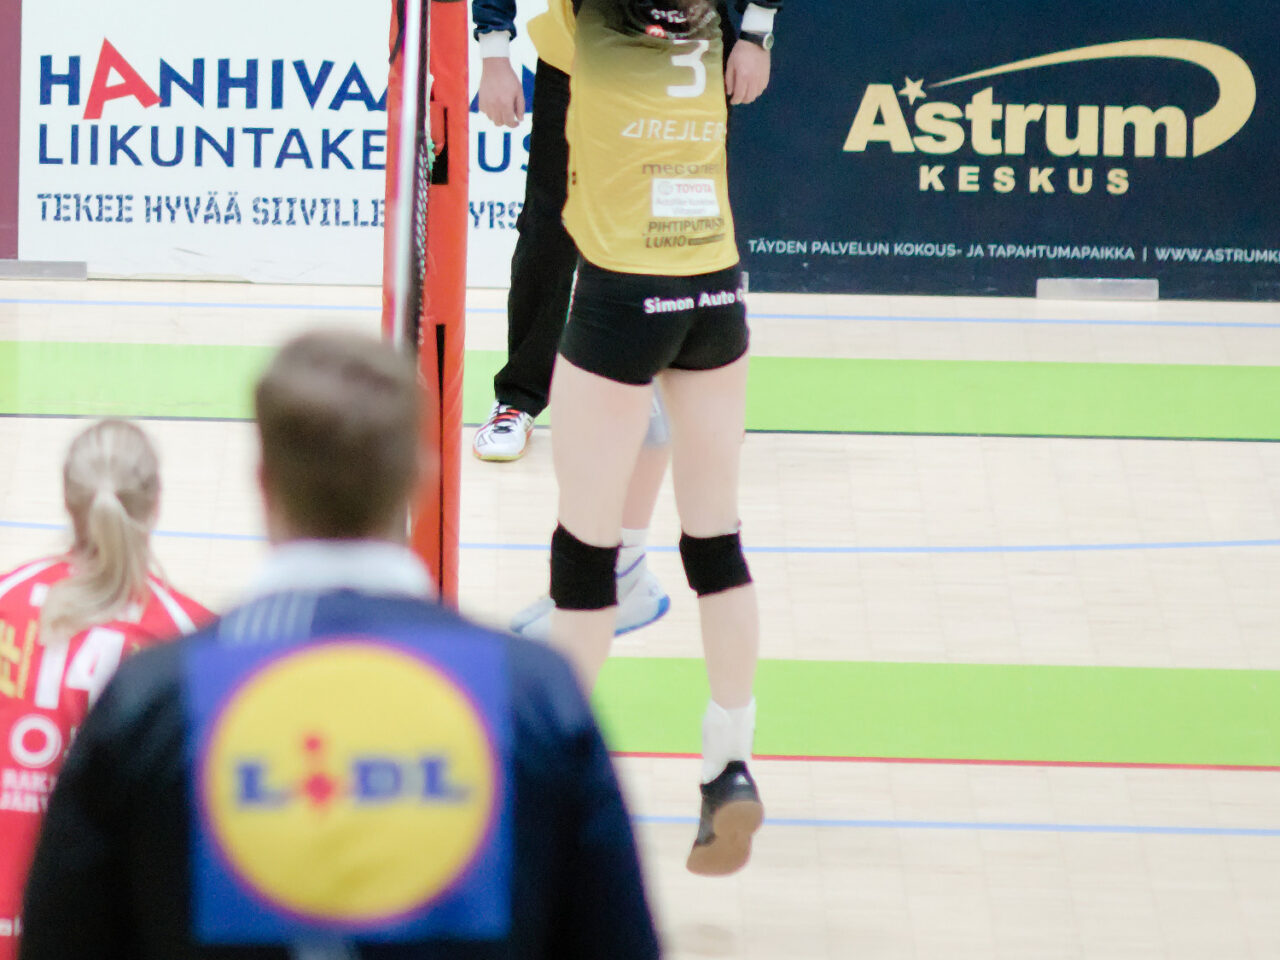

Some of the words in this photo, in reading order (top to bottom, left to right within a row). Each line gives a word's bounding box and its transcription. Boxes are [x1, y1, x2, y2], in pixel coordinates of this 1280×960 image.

[38, 36, 535, 120] HANHIVA
[666, 40, 710, 98] 3
[842, 76, 1189, 159] Astrum
[675, 183, 712, 194] TOYOTA
[919, 164, 1131, 195] KESKUS
[37, 193, 134, 224] TEKEE
[144, 191, 242, 225] HYVÄÄ
[748, 237, 807, 255] TÄYDEN
[811, 241, 890, 256] PALVELUN
[893, 243, 962, 257] KOKOUS-
[966, 244, 984, 258] JA
[987, 244, 1136, 261] TAPAHTUMAPAIKKA
[644, 296, 695, 315] Simon
[698, 291, 735, 309] Auto
[34, 626, 125, 709] 14
